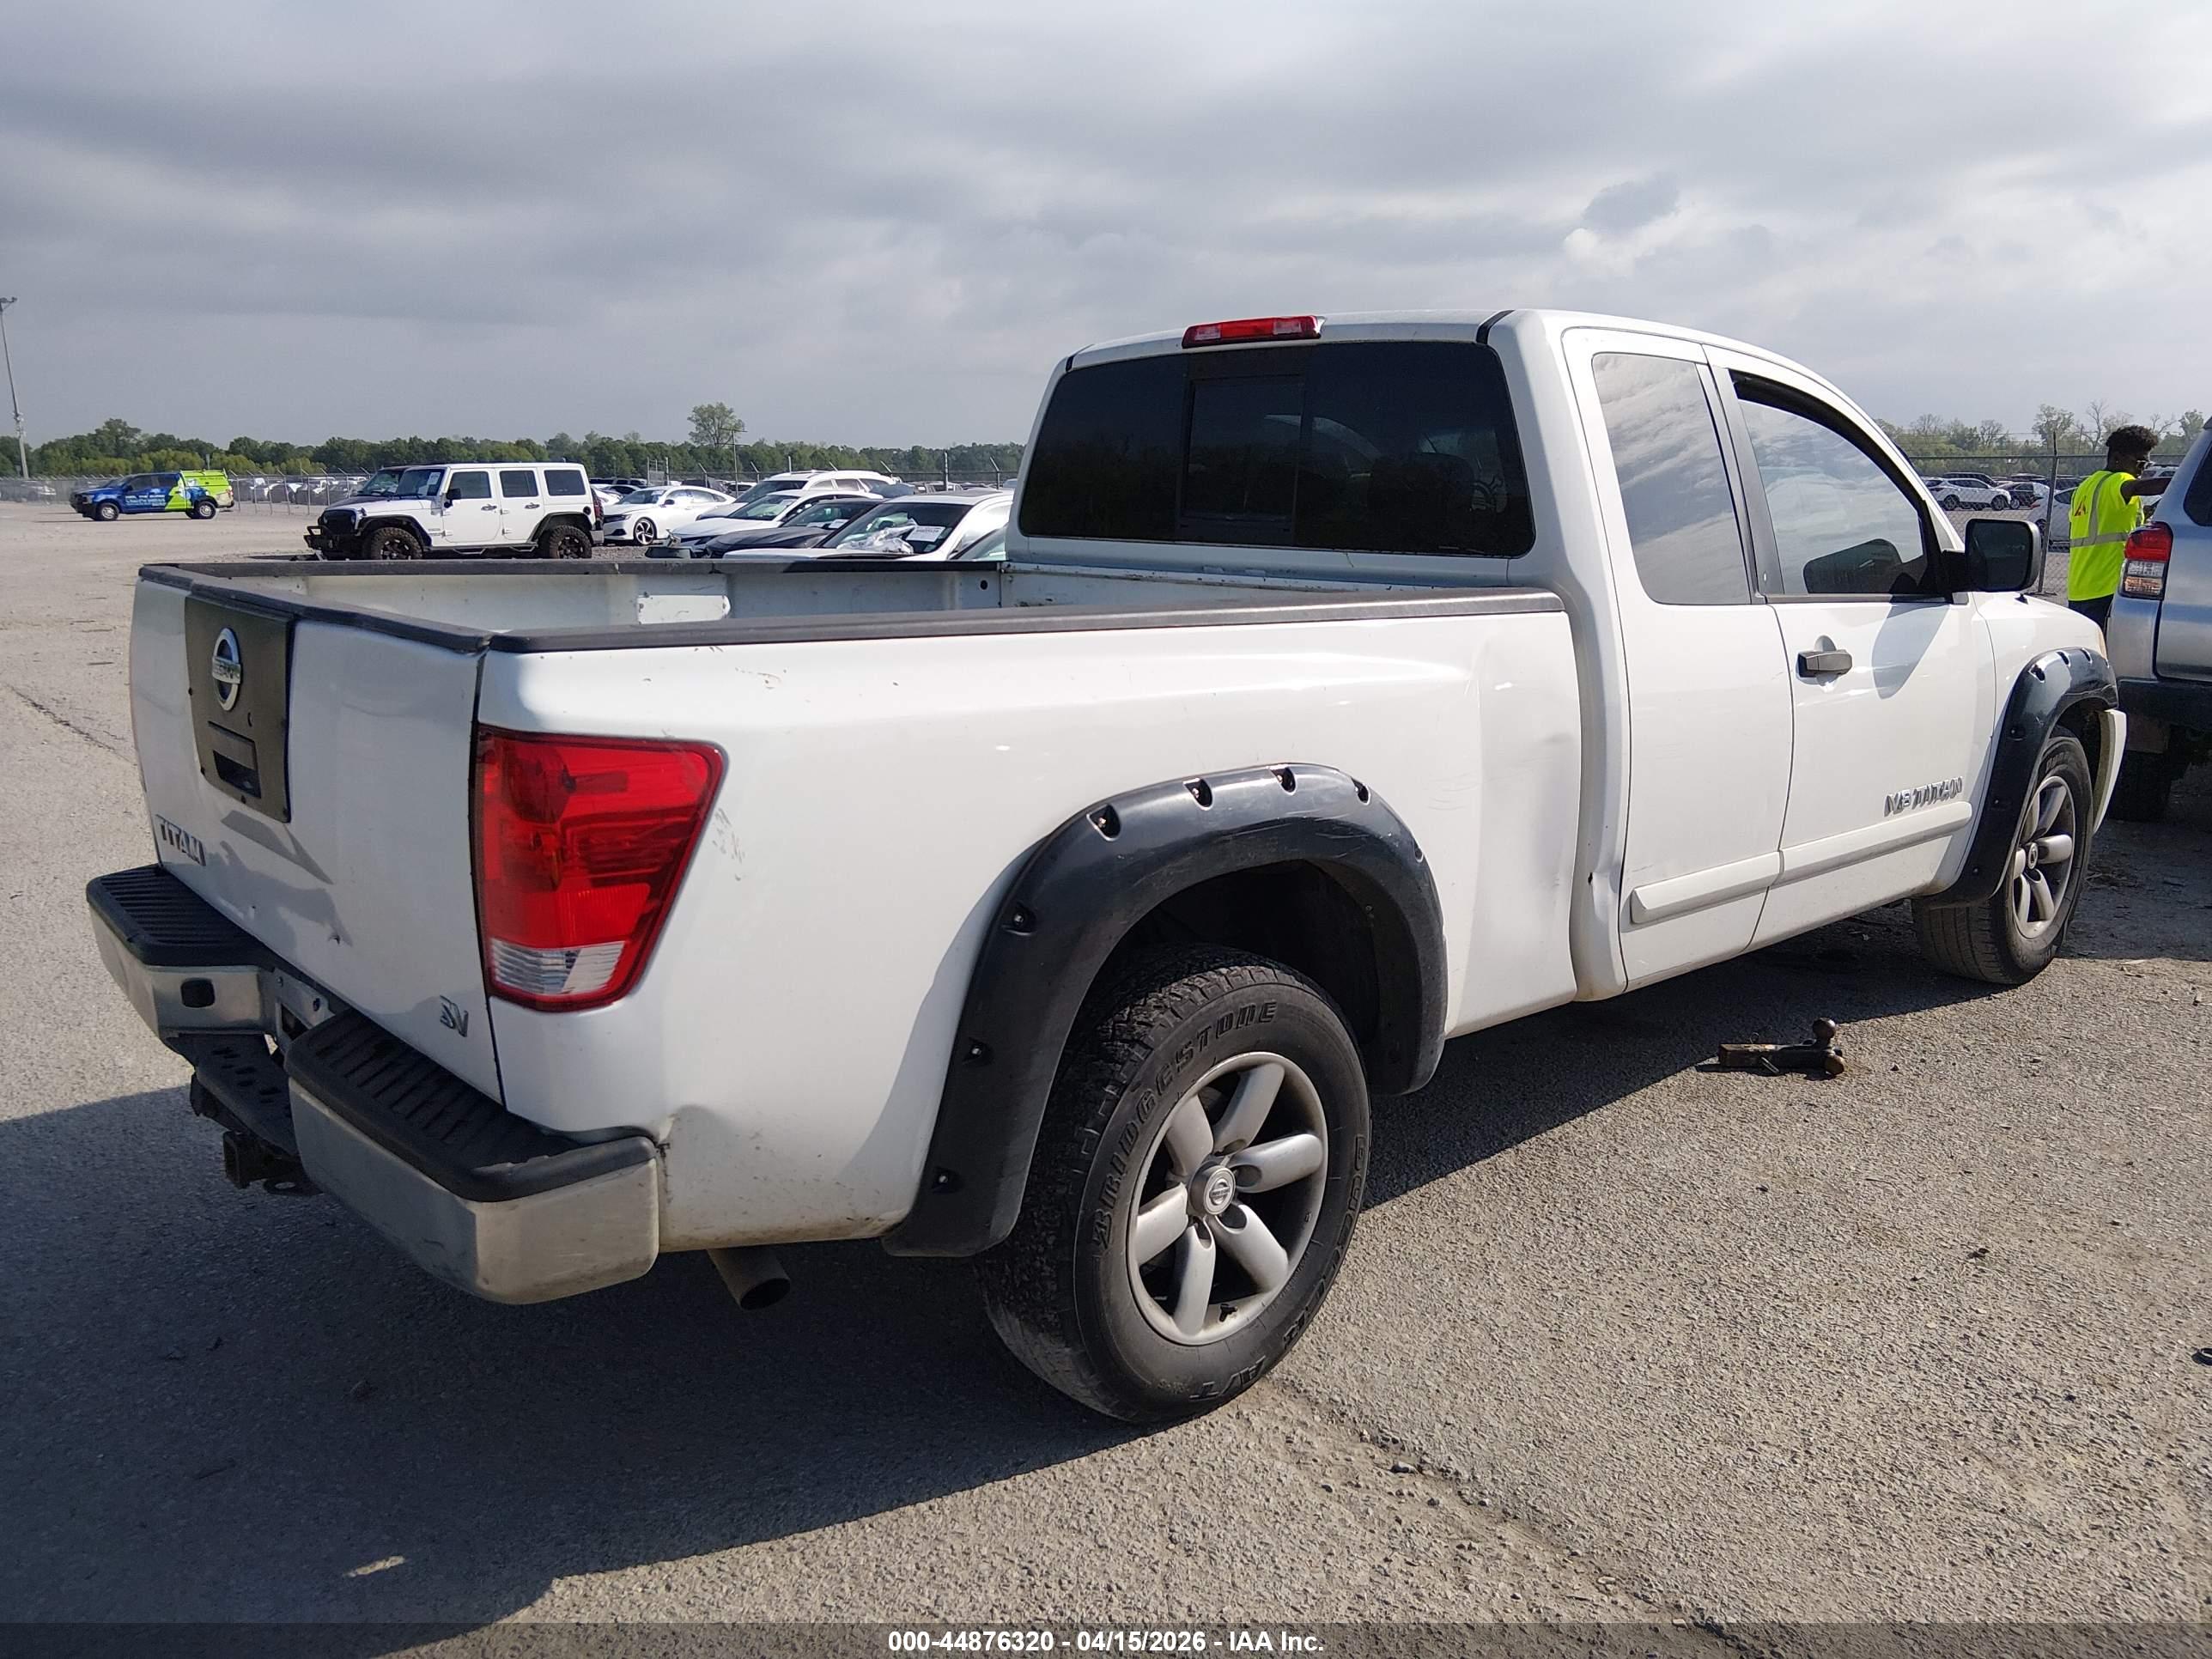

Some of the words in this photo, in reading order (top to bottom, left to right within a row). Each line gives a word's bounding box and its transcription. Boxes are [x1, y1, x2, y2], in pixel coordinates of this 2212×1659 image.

[1884, 790, 1911, 817] V8
[1912, 777, 1962, 810] TITAN
[155, 813, 206, 866] TITAN
[440, 994, 468, 1037] SV
[1092, 1000, 1277, 1250] BRIDGESTONE
